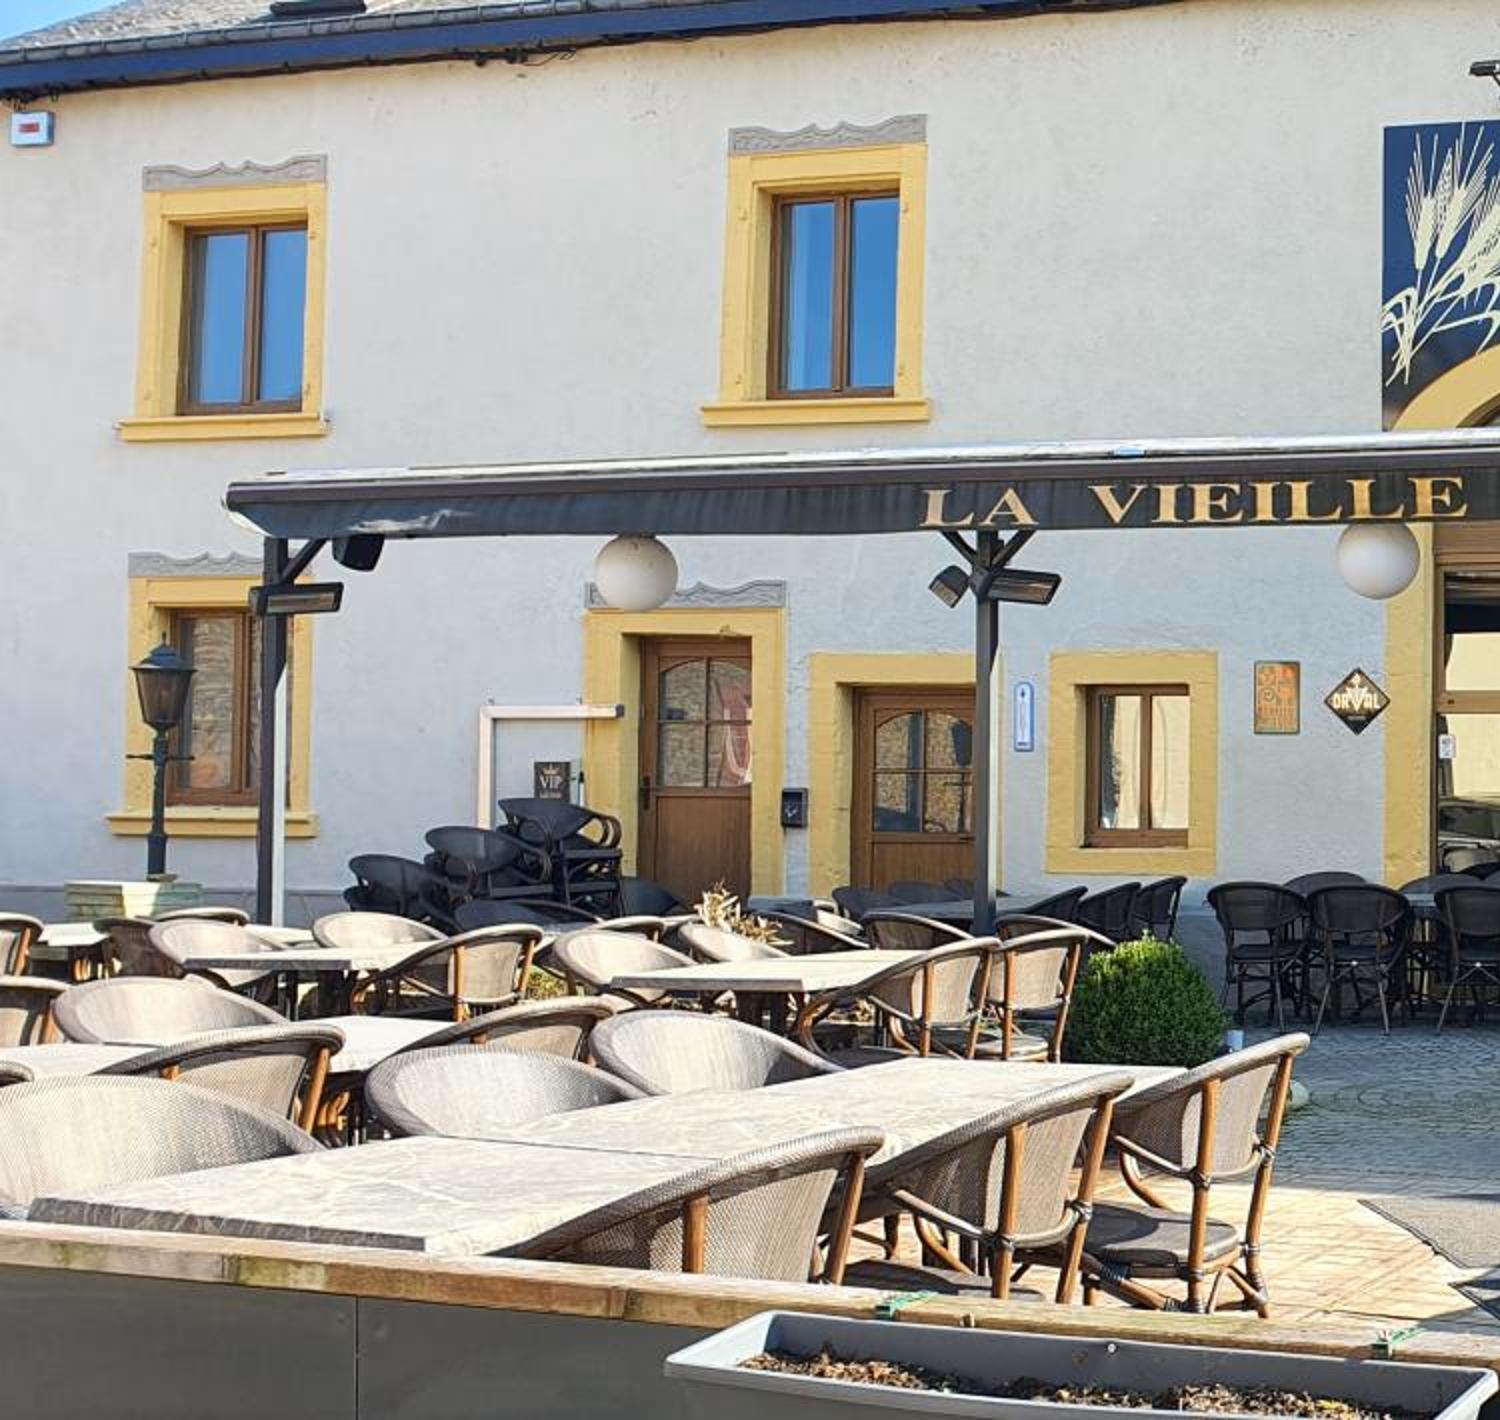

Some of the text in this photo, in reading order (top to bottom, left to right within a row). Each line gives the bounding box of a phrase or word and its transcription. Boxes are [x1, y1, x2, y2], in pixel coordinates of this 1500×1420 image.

[919, 487, 1039, 528] LA
[1088, 476, 1469, 525] VIEILLE
[1333, 687, 1380, 712] ORVAL
[540, 775, 563, 789] VIP
